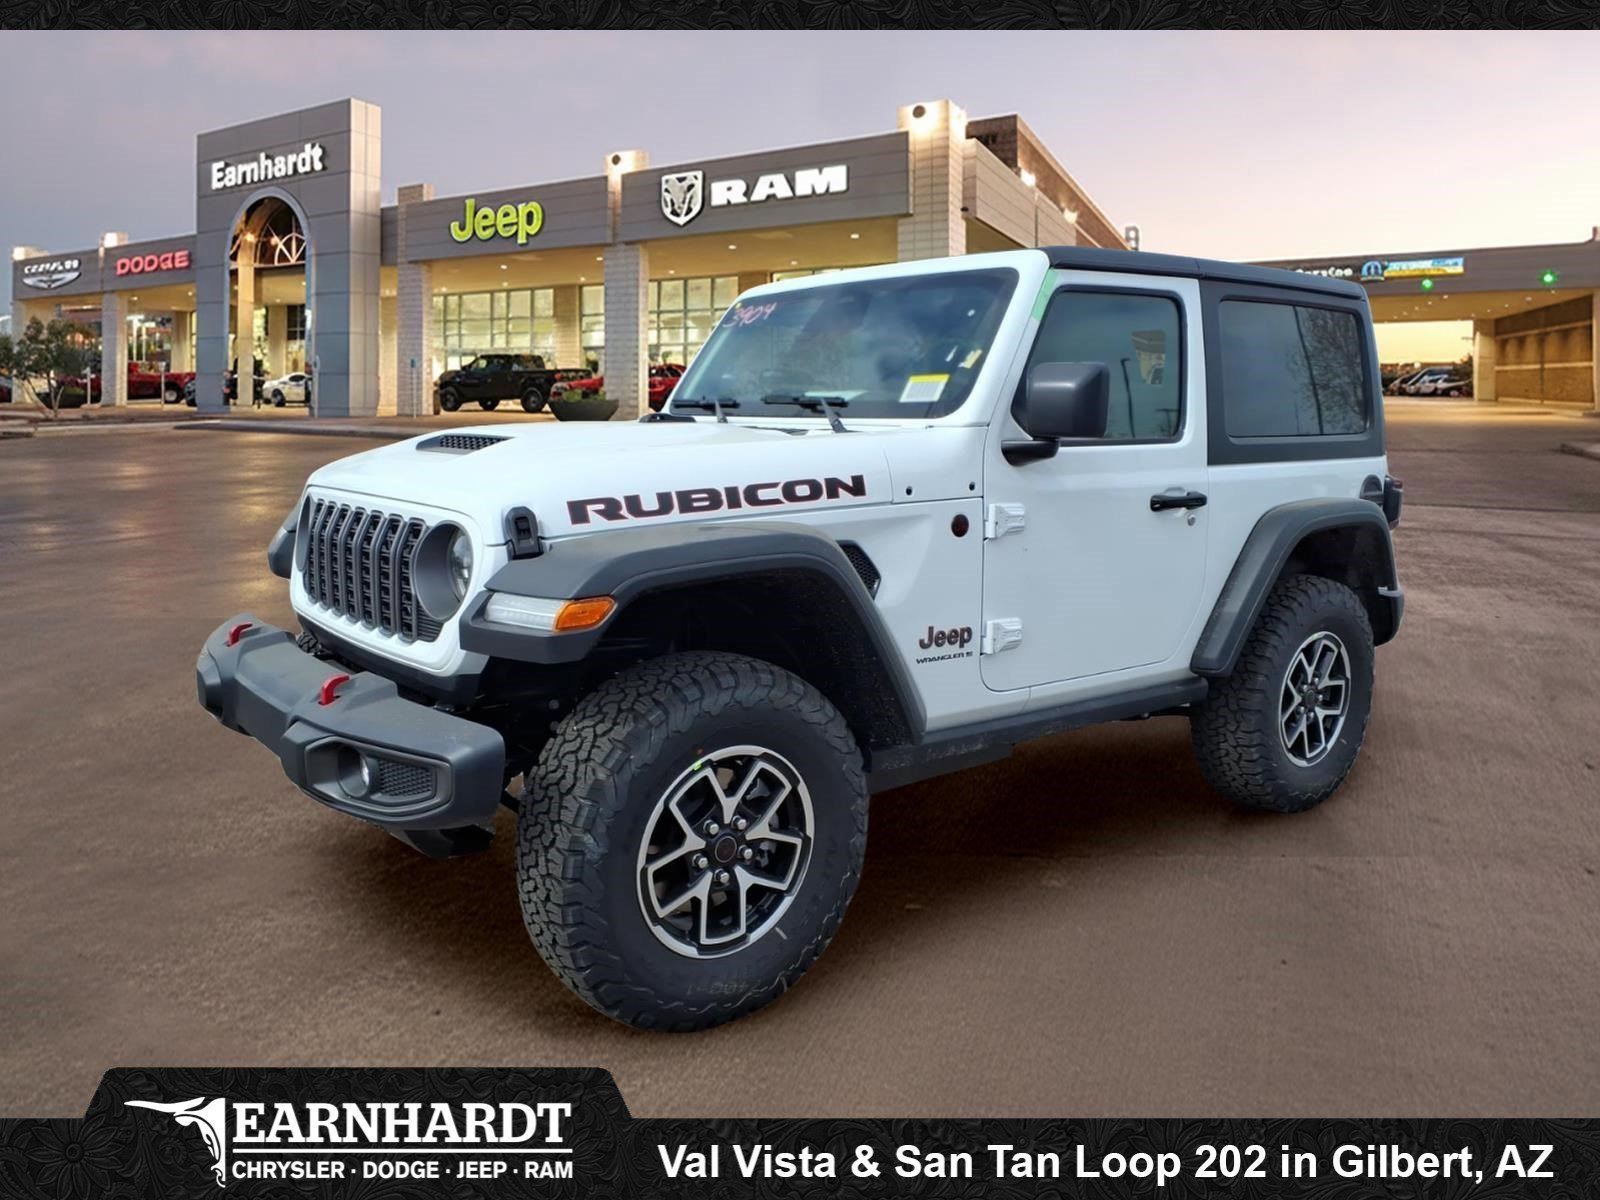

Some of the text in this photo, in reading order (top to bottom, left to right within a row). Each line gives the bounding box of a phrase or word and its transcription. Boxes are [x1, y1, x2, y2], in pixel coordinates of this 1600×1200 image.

[211, 143, 324, 190] Earnhardt
[711, 165, 848, 206] RAM
[450, 199, 543, 244] Jeep
[116, 250, 190, 276] DODGE
[567, 475, 866, 525] RUBICON
[919, 626, 973, 649] Jeep
